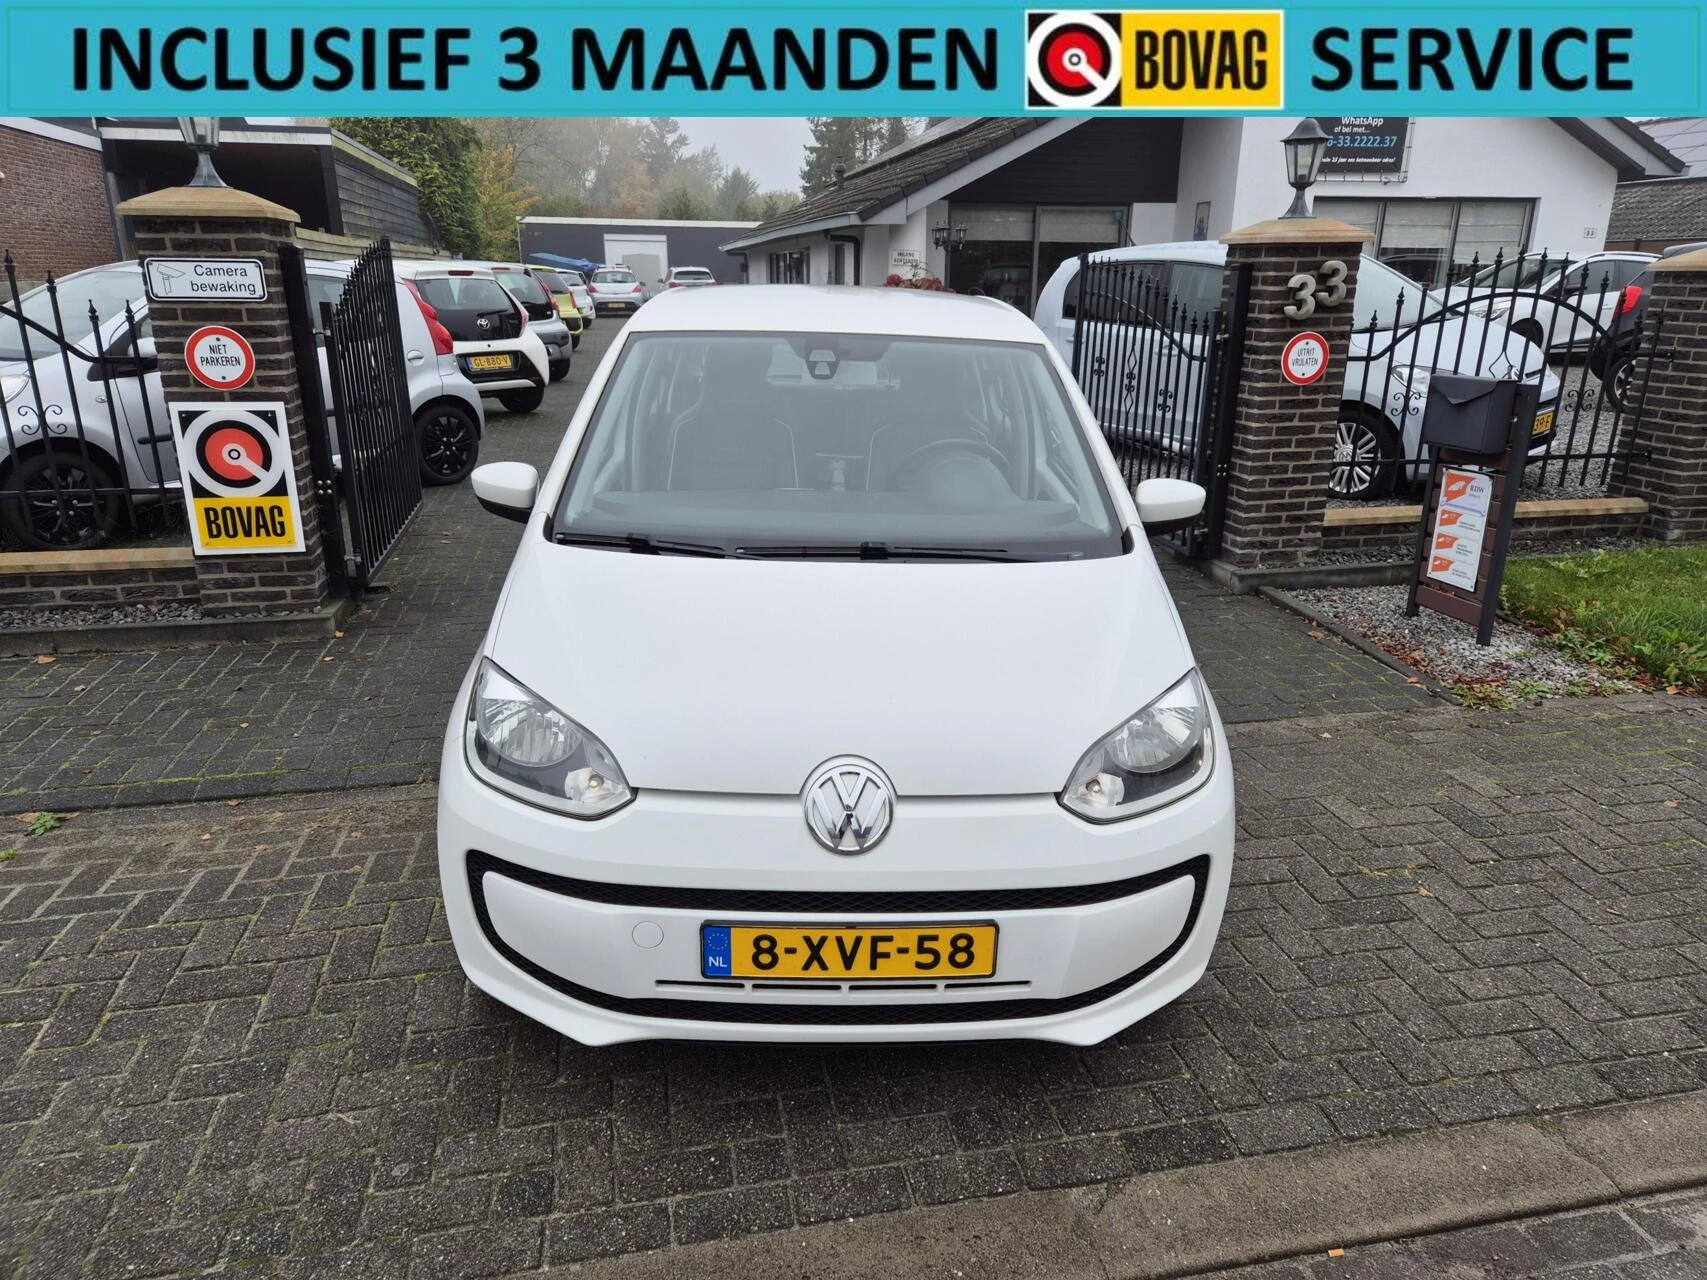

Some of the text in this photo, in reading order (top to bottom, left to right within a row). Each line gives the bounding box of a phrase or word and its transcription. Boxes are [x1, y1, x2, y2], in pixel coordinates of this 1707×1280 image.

[1341, 117, 1384, 126] WhatsApp
[1327, 136, 1397, 147] 6-33.2222.37
[193, 264, 248, 277] Camera
[190, 280, 257, 296] bewaking
[1283, 260, 1348, 320] 33
[208, 344, 227, 355] NIET
[1297, 347, 1315, 357] UITRIT
[200, 356, 241, 367] PARKEREN
[204, 505, 286, 539] BOVAG
[708, 932, 975, 971] NL 8-XVF-58
